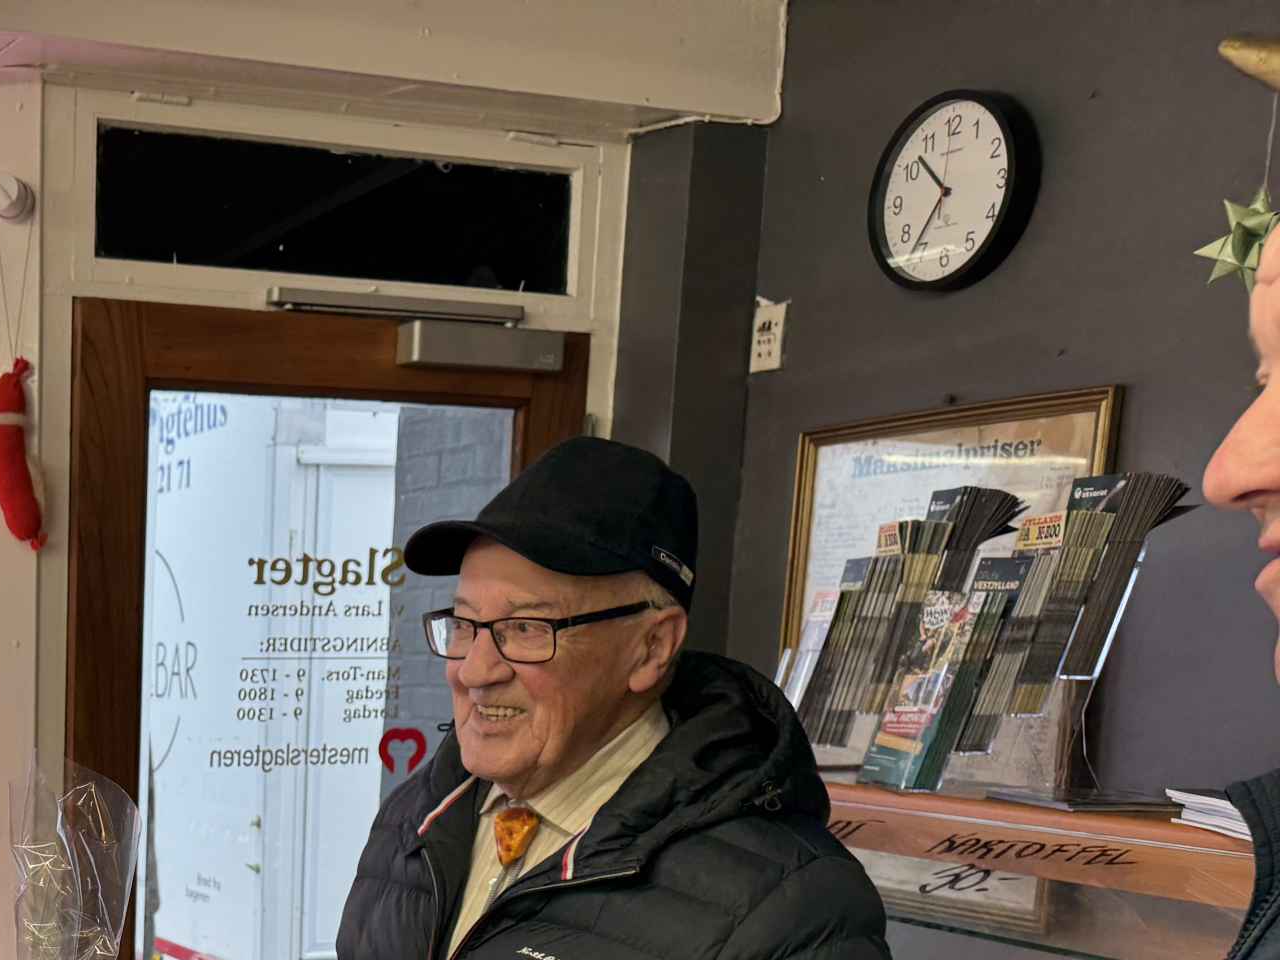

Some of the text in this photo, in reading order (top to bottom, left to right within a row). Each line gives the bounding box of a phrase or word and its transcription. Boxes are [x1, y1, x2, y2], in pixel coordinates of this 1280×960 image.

[944, 113, 963, 137] 12
[972, 117, 980, 140] 1
[921, 132, 936, 154] 11
[989, 136, 1002, 159] 2
[903, 160, 920, 183] 10
[995, 167, 1008, 189] 3
[892, 195, 904, 216] 9
[985, 202, 997, 222] 4
[901, 223, 912, 244] 8
[964, 230, 976, 252] 5
[939, 247, 950, 268] 6
[927, 831, 1138, 867] KARTOFFEL
